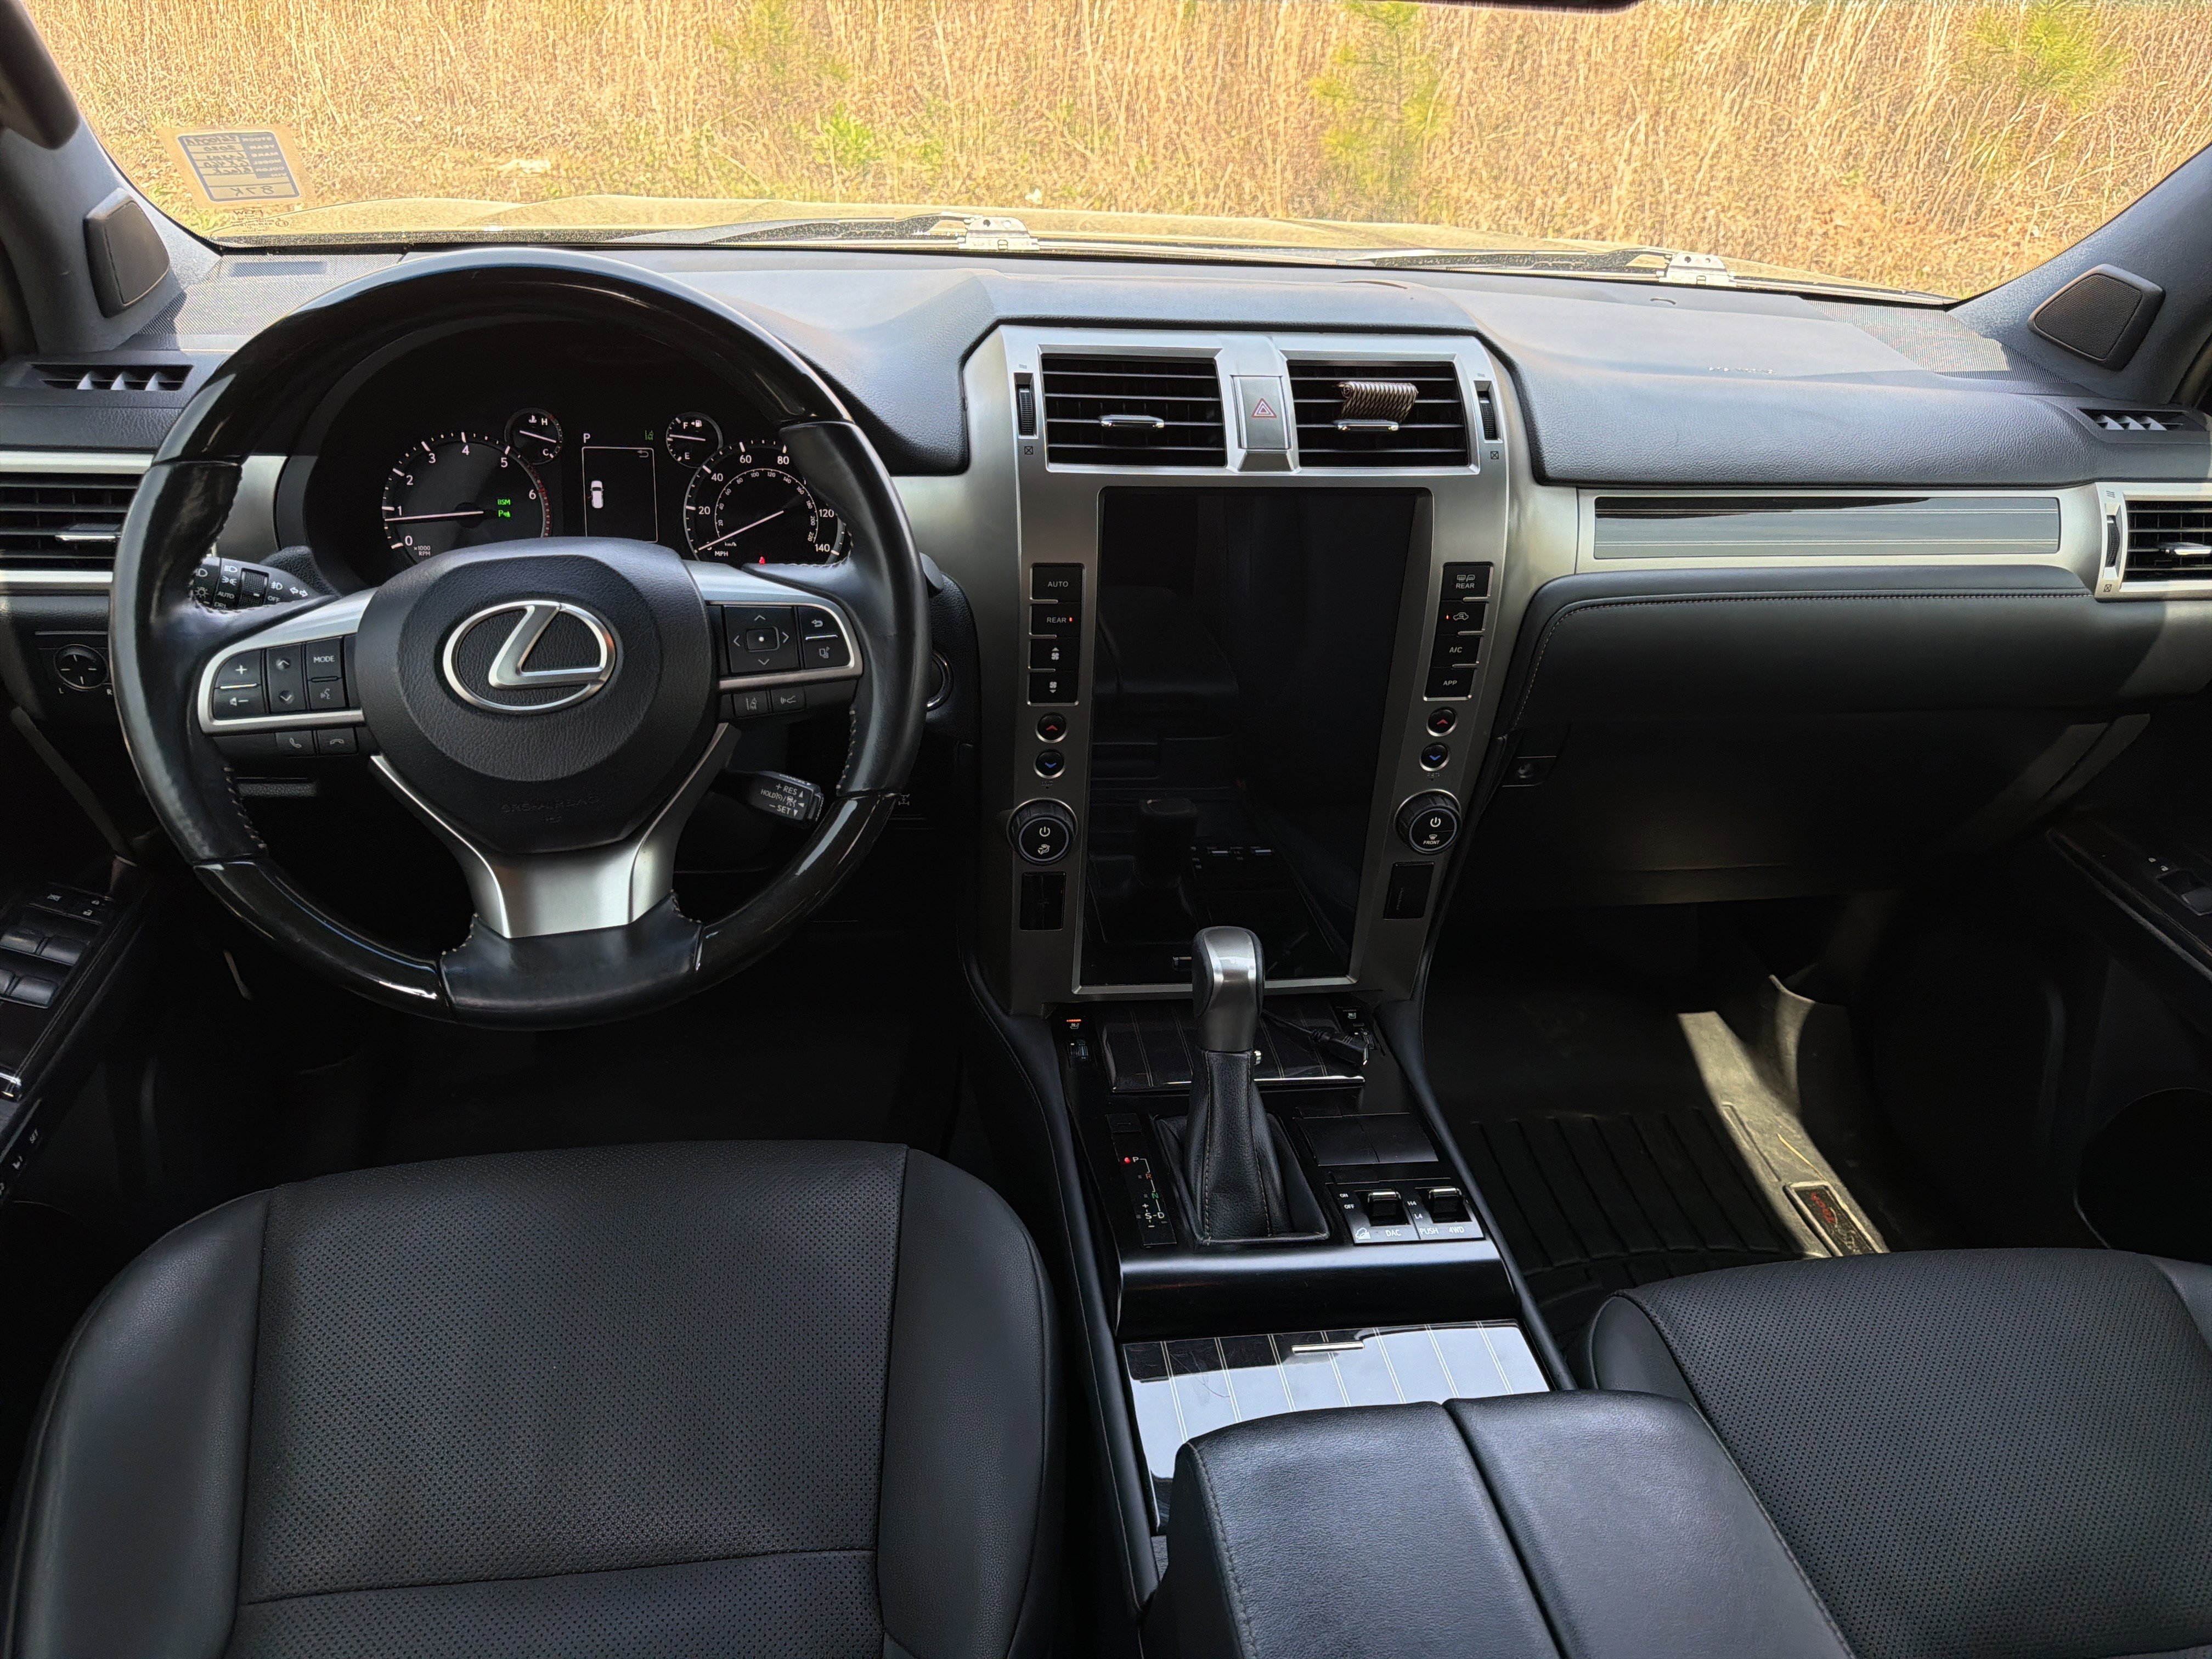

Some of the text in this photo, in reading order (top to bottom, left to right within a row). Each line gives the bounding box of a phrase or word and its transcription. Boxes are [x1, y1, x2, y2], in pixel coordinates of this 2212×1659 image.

[541, 417, 548, 426] H
[583, 433, 591, 443] P
[461, 445, 470, 456] 4
[543, 448, 549, 456] C
[428, 453, 436, 464] 3
[685, 452, 691, 460] E
[740, 455, 752, 465] 60
[777, 455, 790, 465] 80
[500, 457, 508, 468] 5
[405, 475, 414, 486] 2
[711, 473, 724, 482] 40
[528, 489, 537, 500] 6
[397, 505, 403, 516] 1
[698, 506, 710, 515] 20
[819, 509, 834, 518] 120
[405, 535, 413, 546] 0
[815, 544, 831, 552] 140
[217, 591, 235, 599] AUTO
[1448, 646, 1463, 654] A/C
[312, 654, 335, 664] MODE
[760, 788, 776, 798] HOLD
[783, 786, 798, 795] RES
[777, 805, 791, 815] SET
[1385, 1229, 1402, 1237] DAC
[1419, 1226, 1440, 1235] PUSH
